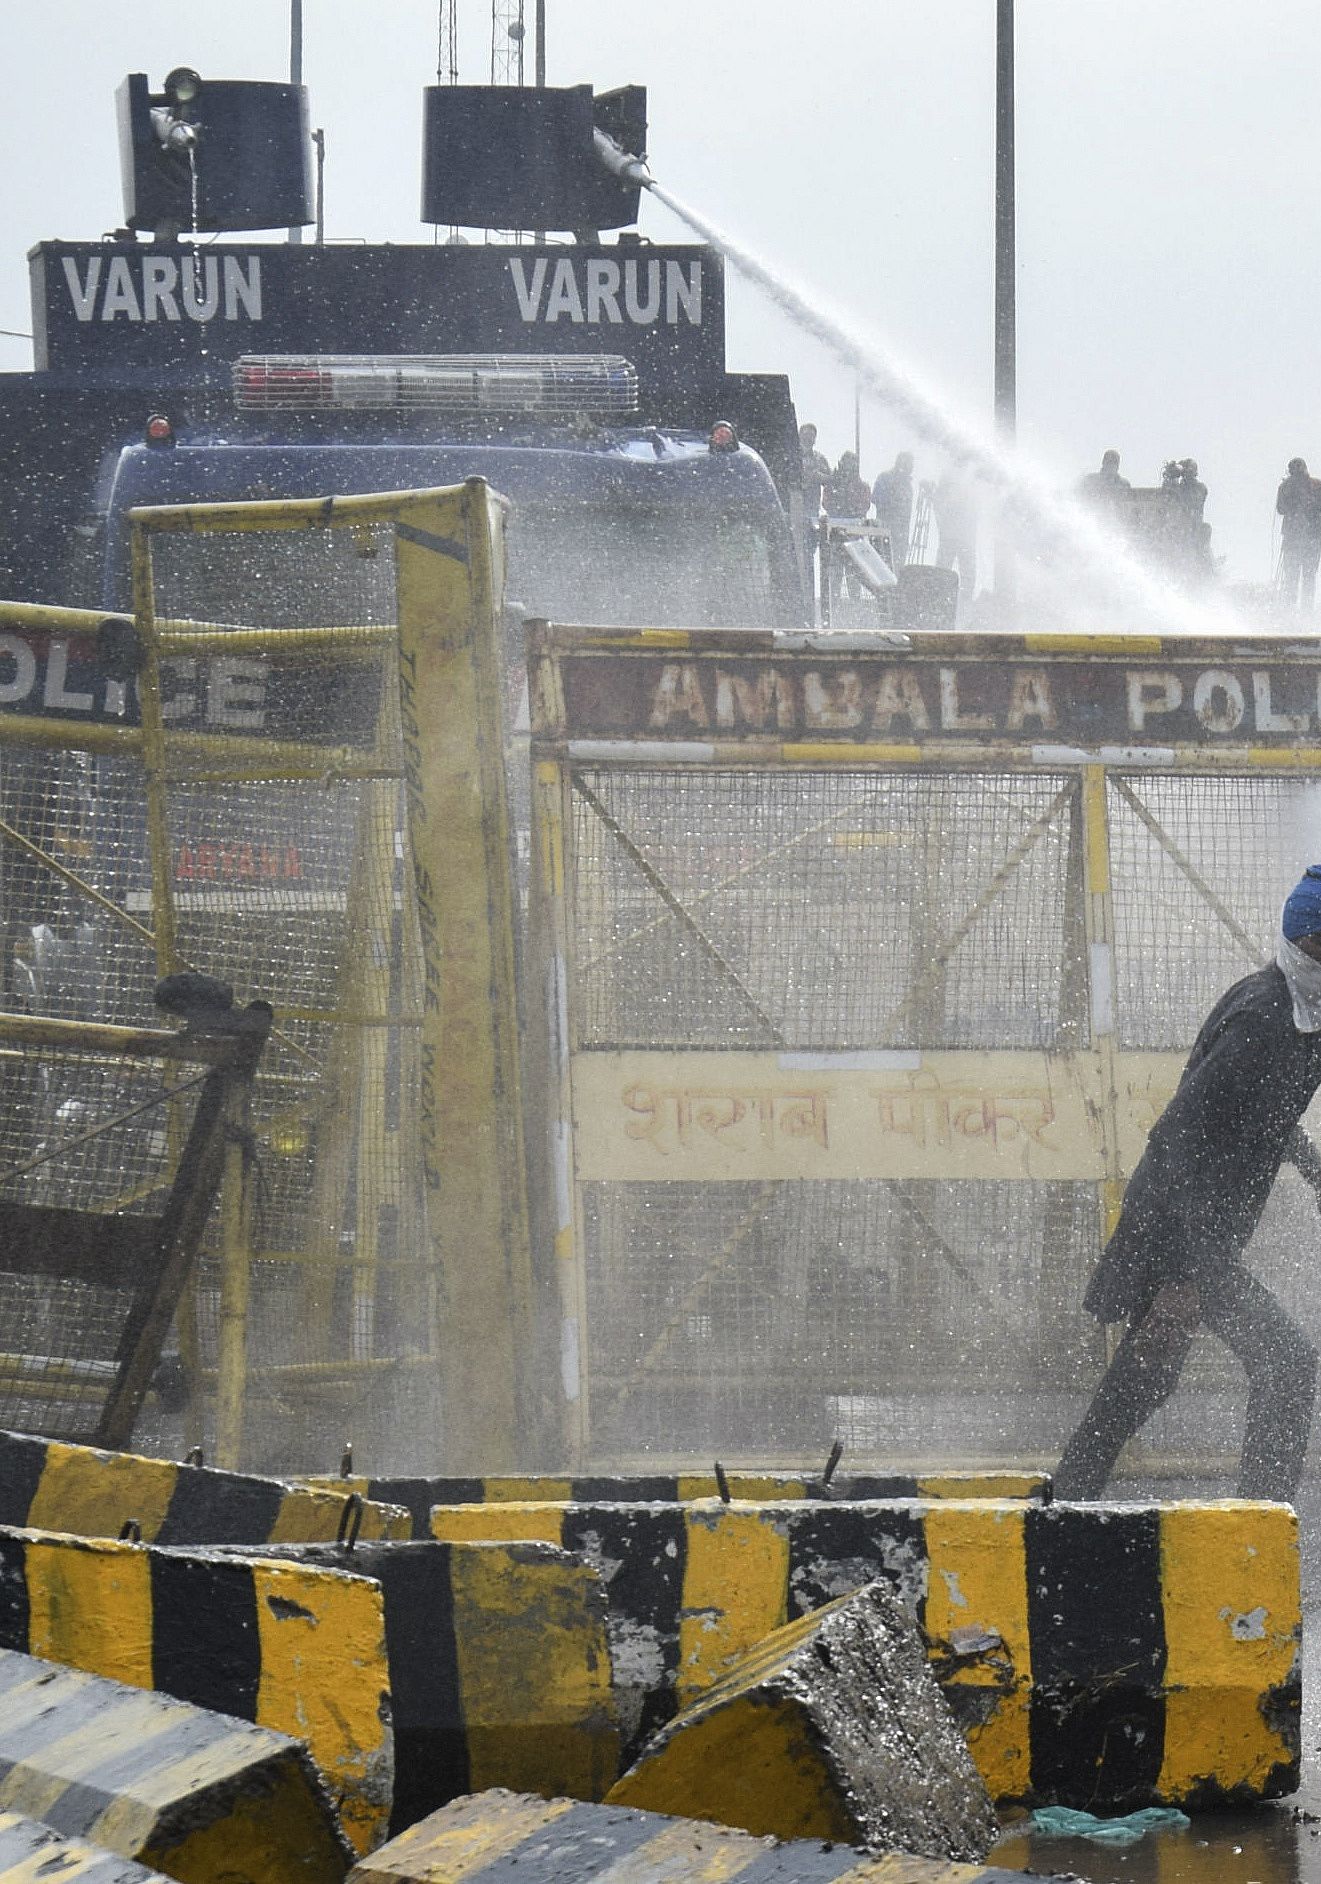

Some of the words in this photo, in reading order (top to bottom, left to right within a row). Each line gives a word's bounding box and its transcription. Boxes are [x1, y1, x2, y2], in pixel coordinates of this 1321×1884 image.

[61, 256, 262, 322] VARUN
[511, 257, 702, 325] VARUN
[648, 664, 1060, 731] AMBALA
[622, 1080, 835, 1156] शराब
